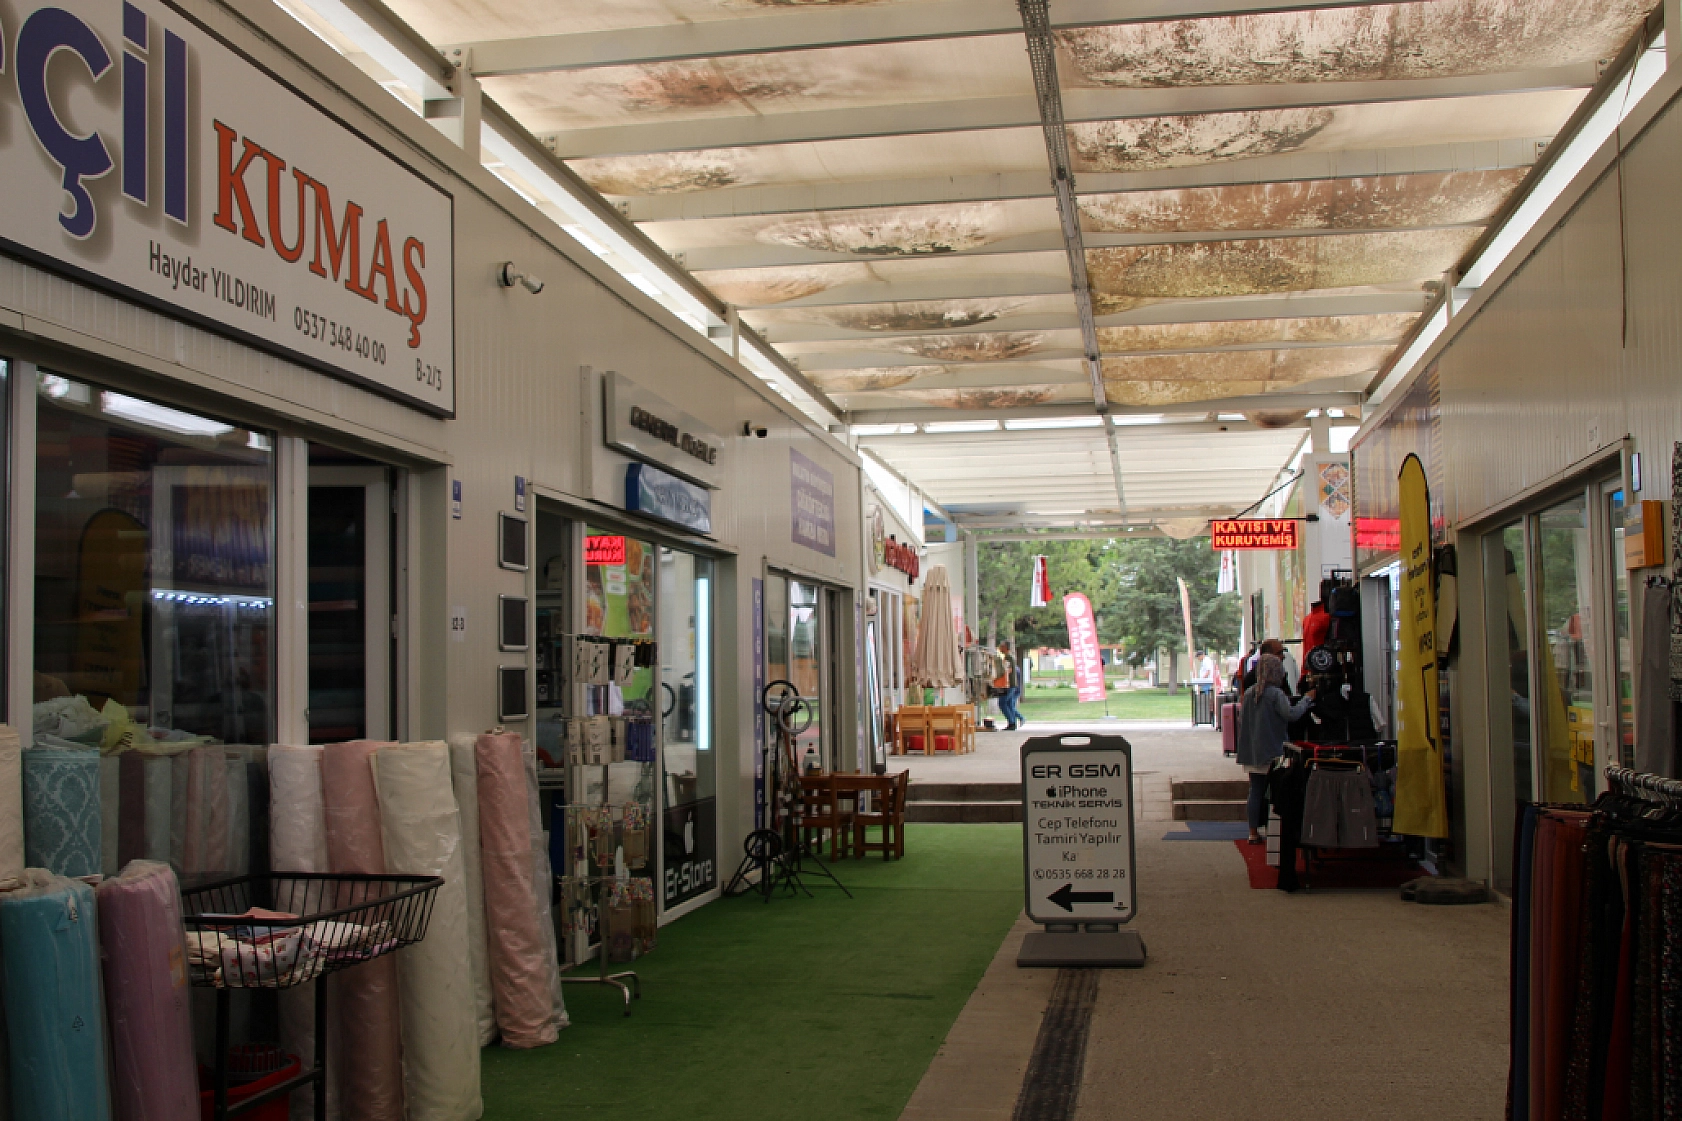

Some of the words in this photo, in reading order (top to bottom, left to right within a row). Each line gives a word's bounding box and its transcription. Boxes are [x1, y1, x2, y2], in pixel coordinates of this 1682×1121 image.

[0, 0, 188, 240] çil
[213, 119, 428, 349] KUMAŞ
[149, 240, 207, 294] Haydar
[211, 266, 276, 322] YILDIRIM
[294, 305, 326, 341] 0537
[329, 321, 352, 349] 348
[354, 331, 370, 360] 40
[371, 341, 387, 366] 00
[416, 358, 442, 391] B-2/3
[1215, 521, 1268, 534] KAYISI
[1272, 521, 1292, 532] VE
[1215, 534, 1292, 547] KURUYEMİŞ
[1031, 764, 1062, 779] ER
[1068, 763, 1121, 779] GSM
[1058, 785, 1108, 798] iPhone
[1038, 816, 1062, 831] Cep
[1064, 816, 1118, 829] Telefonu
[1035, 832, 1078, 845] Tamiri
[1079, 832, 1122, 847] Yapılır
[665, 858, 712, 900] Er-Store
[1045, 868, 1072, 880] 0535
[1074, 868, 1094, 880] 668
[1096, 868, 1110, 880] 28
[1112, 868, 1126, 880] 28
